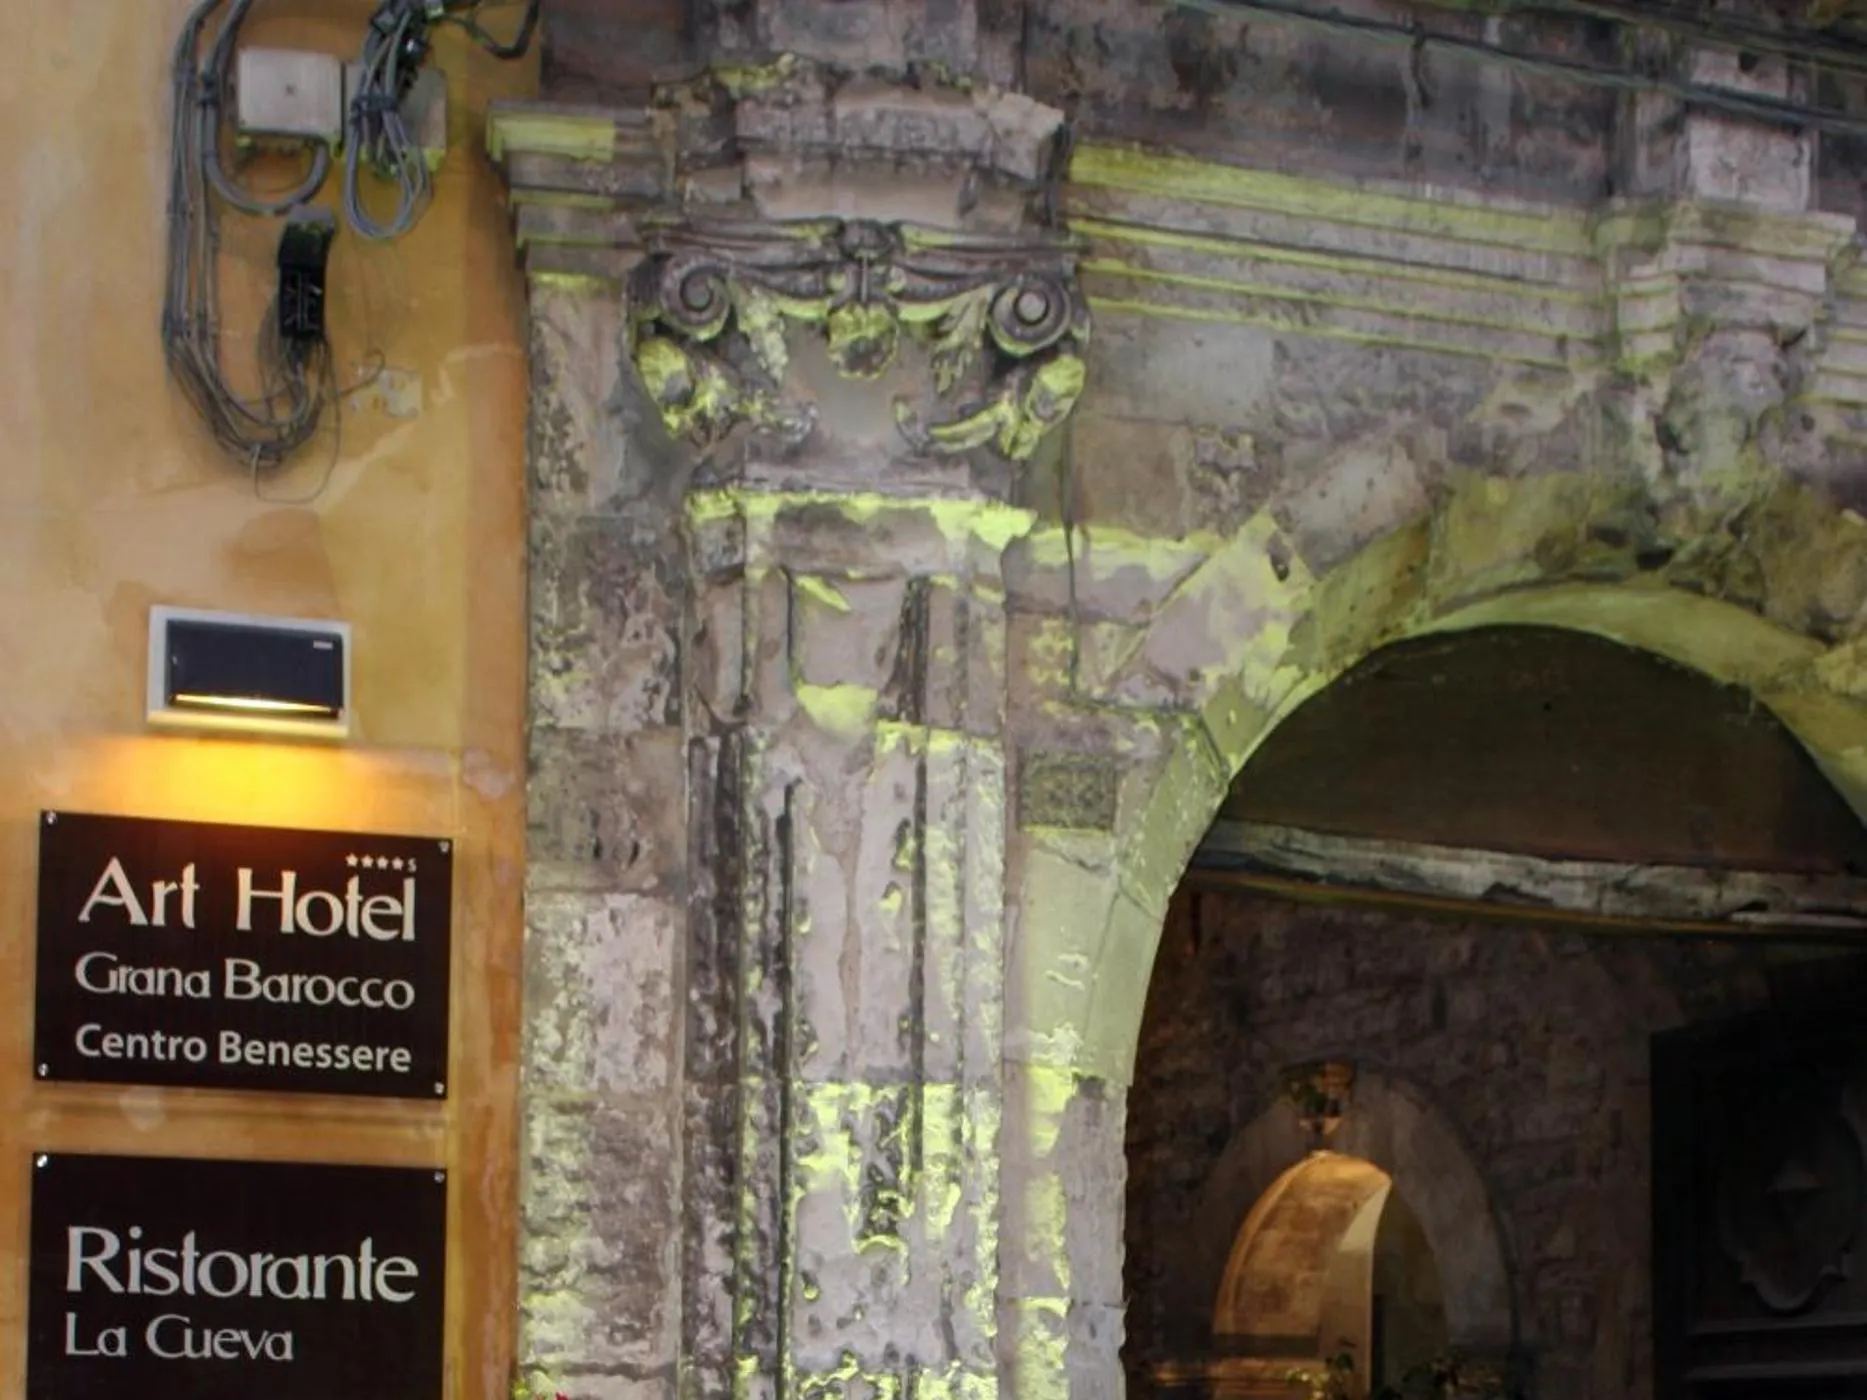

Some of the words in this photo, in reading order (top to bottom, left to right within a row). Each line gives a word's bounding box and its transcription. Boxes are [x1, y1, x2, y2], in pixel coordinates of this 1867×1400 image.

[78, 856, 201, 929] Art
[236, 867, 416, 941] Hotel
[75, 951, 211, 998] Grana
[224, 957, 416, 1010] Barocco
[75, 1023, 207, 1062] Centro
[219, 1030, 412, 1073] Benessere
[66, 1226, 419, 1303] Ristorante
[65, 1312, 127, 1357] La
[145, 1314, 293, 1361] Cueva
